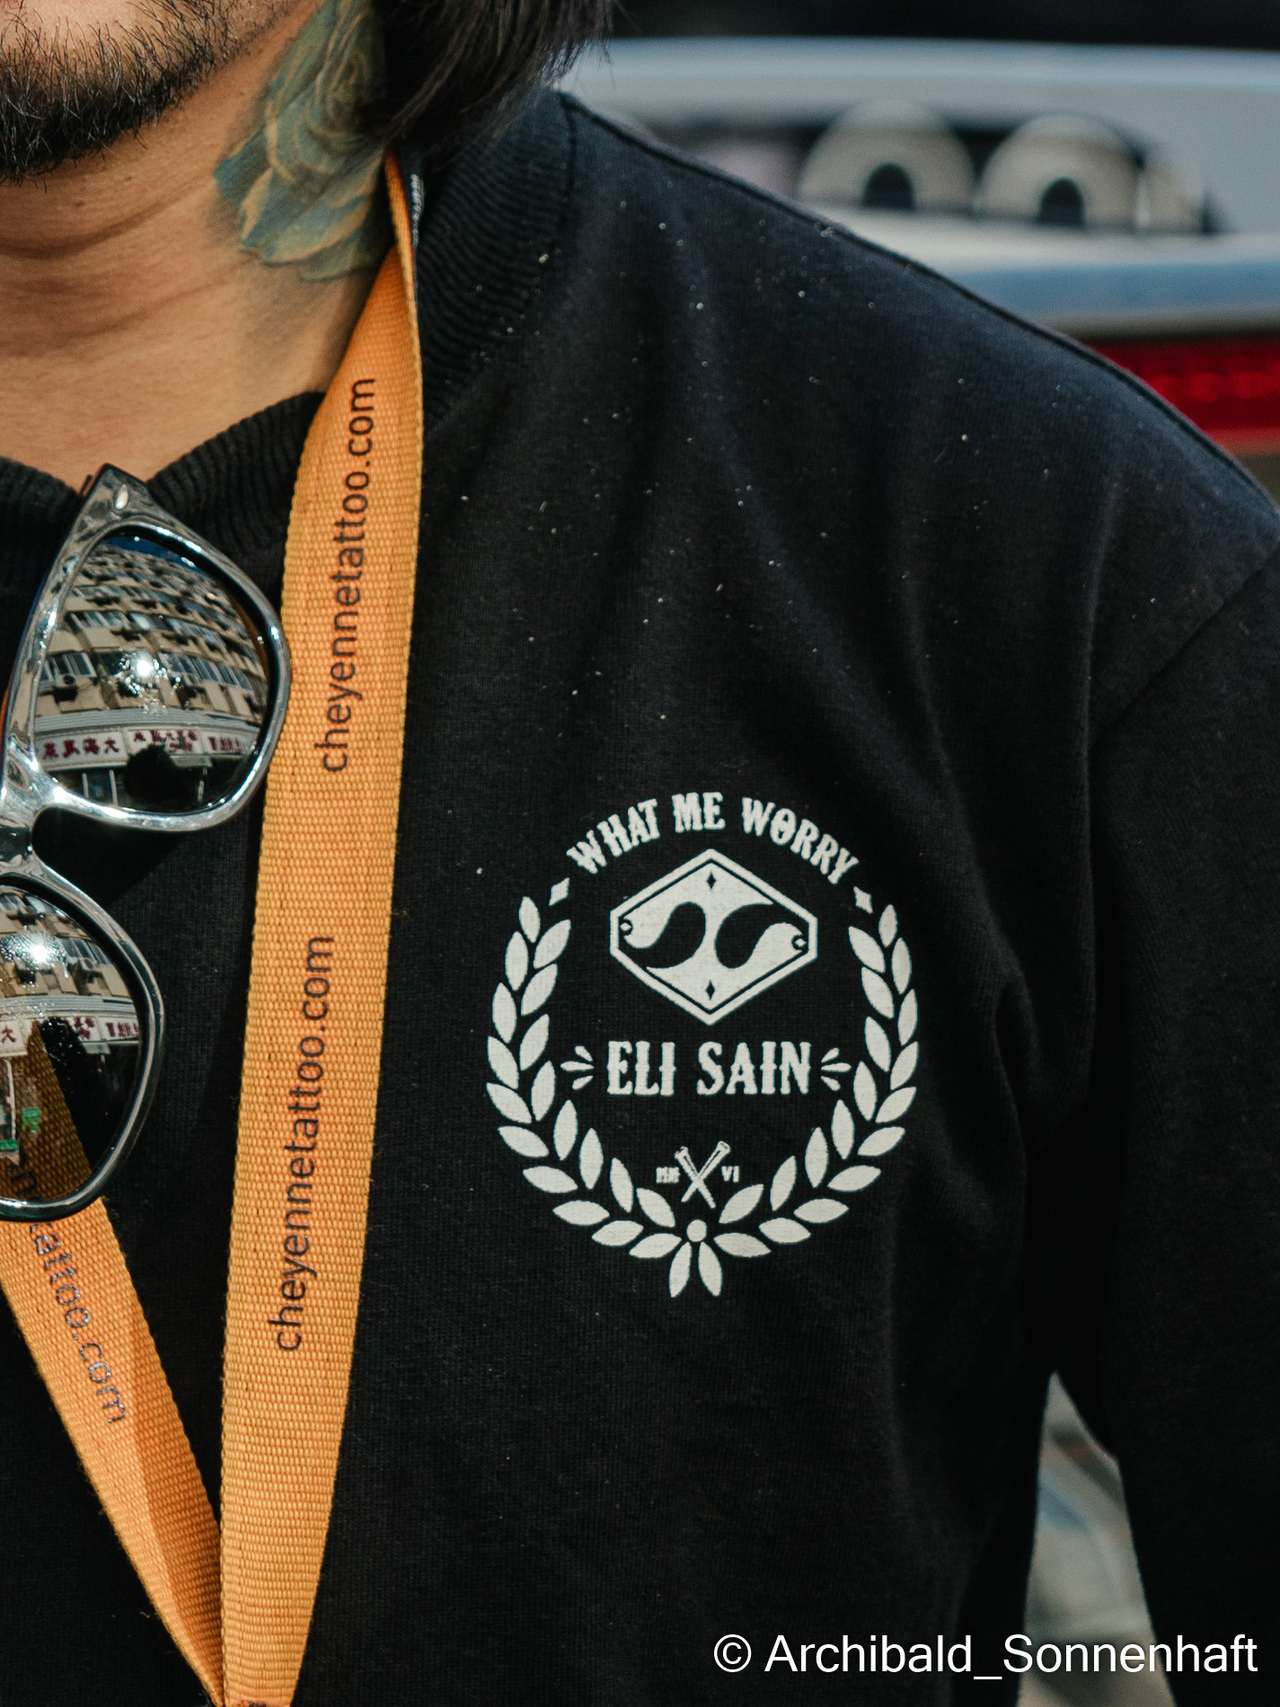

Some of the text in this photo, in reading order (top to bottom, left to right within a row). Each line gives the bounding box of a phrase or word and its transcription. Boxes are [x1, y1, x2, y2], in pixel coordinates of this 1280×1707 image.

[322, 376, 377, 774] cheyennetattoo.com
[567, 792, 858, 885] WHAT ME WORRY
[607, 1041, 811, 1096] ELI SAIN
[268, 933, 334, 1354] cheyennetattoo.com
[722, 1166, 739, 1182] VI
